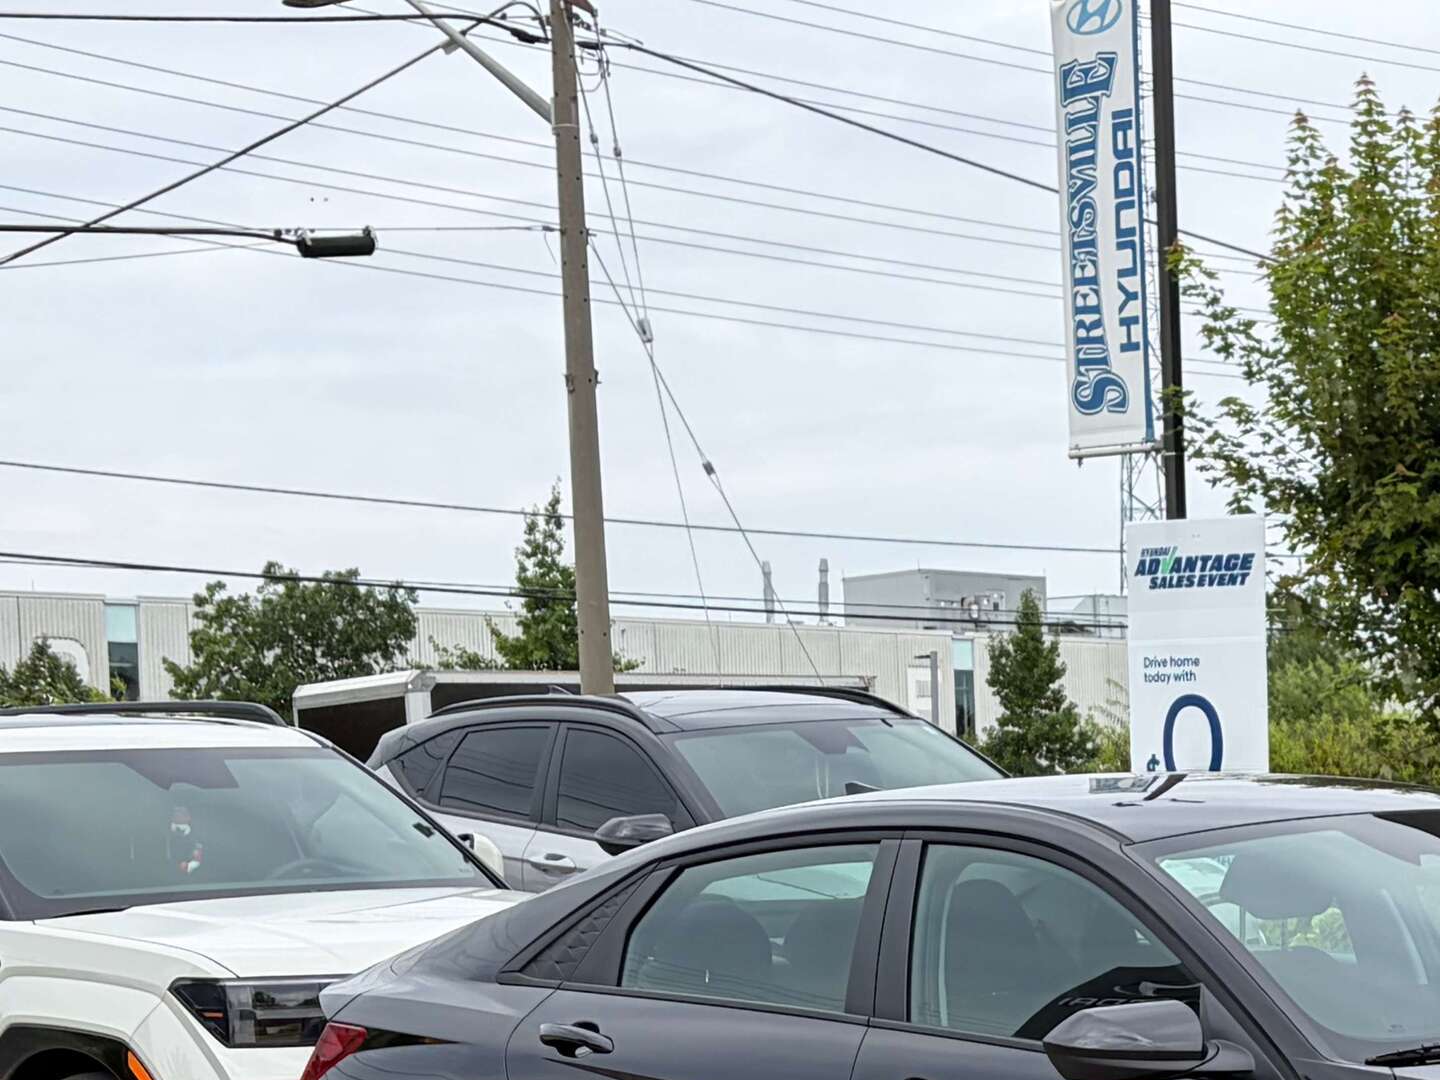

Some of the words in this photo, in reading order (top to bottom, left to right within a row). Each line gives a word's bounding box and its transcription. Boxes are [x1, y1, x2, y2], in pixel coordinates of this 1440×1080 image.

[1060, 52, 1129, 415] STREETSVILLE
[1111, 108, 1141, 354] HYUNDAI
[1134, 546, 1256, 577] ADVANTAGE
[1149, 575, 1196, 590] SALES
[1197, 572, 1251, 587] EVENT
[1143, 656, 1168, 668] Drive
[1169, 656, 1200, 667] home
[1144, 671, 1171, 684] today
[1173, 669, 1196, 682] with
